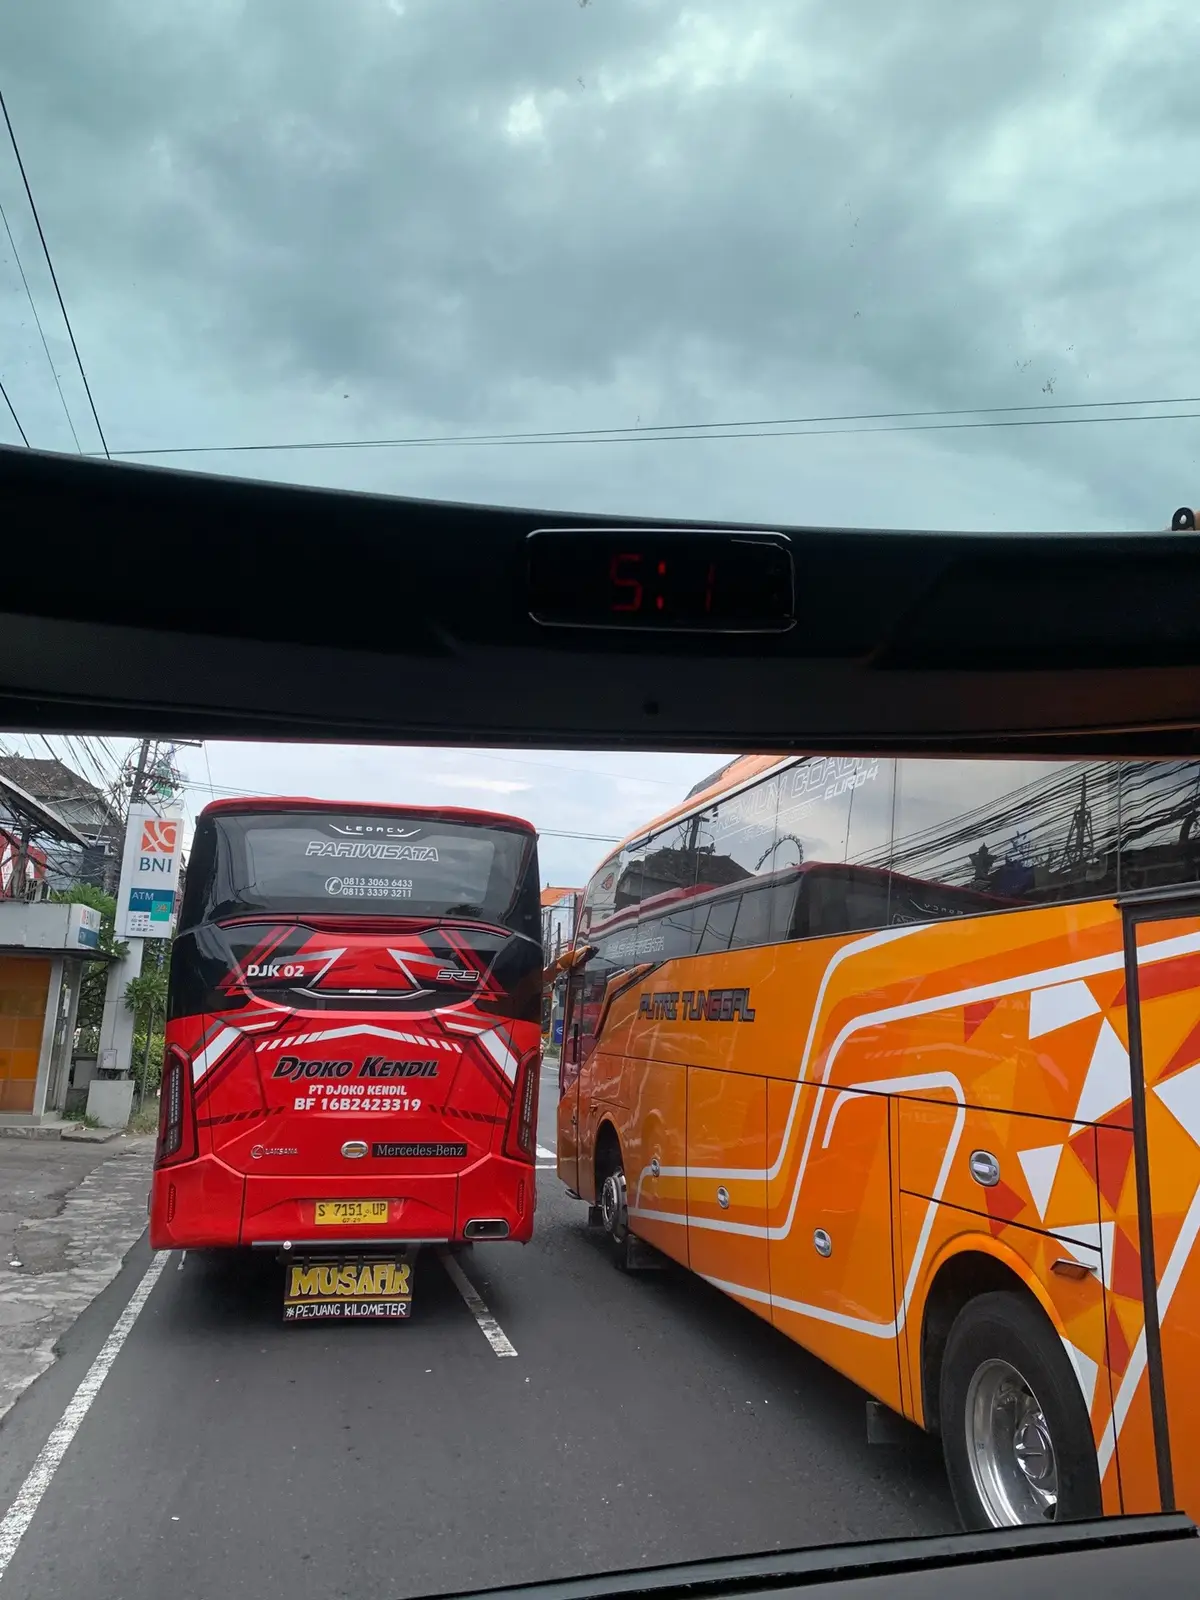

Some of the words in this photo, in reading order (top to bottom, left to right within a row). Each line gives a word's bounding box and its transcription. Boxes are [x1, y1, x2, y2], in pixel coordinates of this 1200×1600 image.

[823, 766, 879, 801] EURO4
[345, 825, 405, 834] LEGACY
[305, 841, 439, 862] PARIWISATA
[139, 857, 172, 873] BNI
[343, 877, 366, 886] 0813
[367, 878, 389, 887] 3063
[391, 879, 413, 888] 6433
[131, 891, 154, 900] ATM
[342, 887, 365, 896] 0813
[366, 888, 389, 897] 3339
[391, 889, 412, 898] 3211
[247, 964, 280, 977] DJK
[283, 965, 305, 977] 02
[309, 1085, 325, 1095] PT
[326, 1085, 364, 1096] DJOKO
[367, 1085, 408, 1096] KENDIL
[294, 1097, 316, 1110] BF
[376, 1144, 464, 1156] Mercedes-Benz
[318, 1204, 326, 1217] S
[334, 1203, 362, 1217] 7151
[372, 1203, 387, 1216] UP
[289, 1264, 411, 1297] MUSAFIR
[286, 1304, 341, 1318] #PEJUANG
